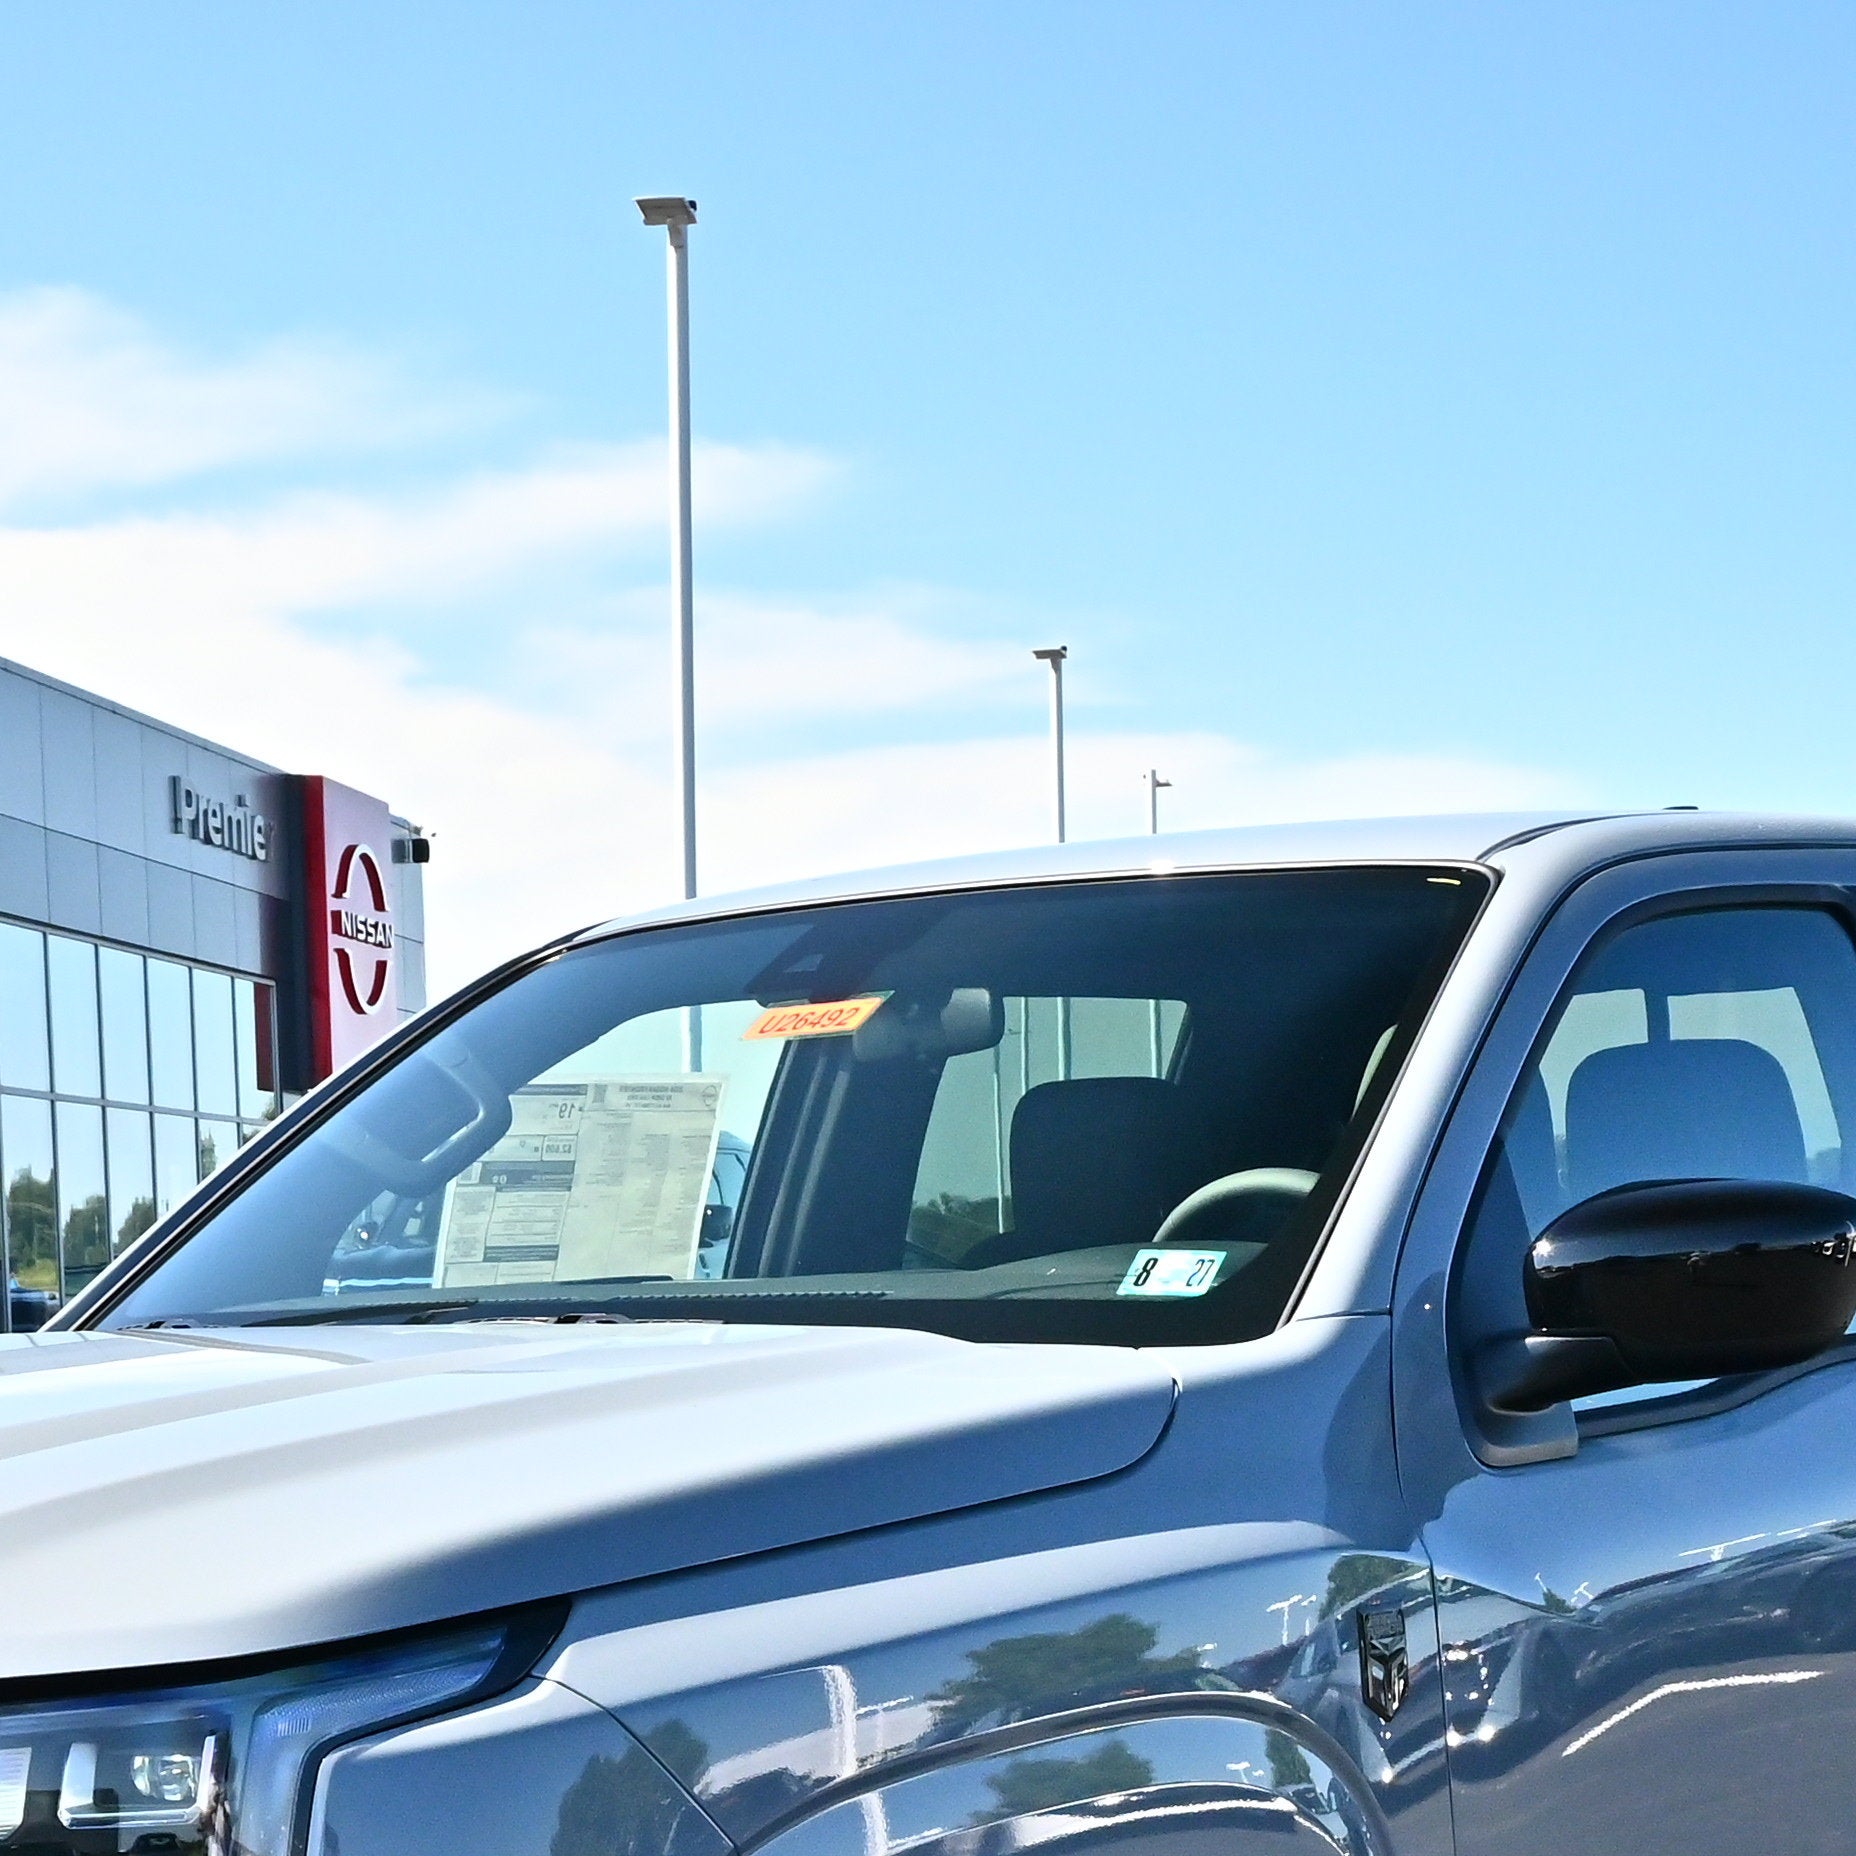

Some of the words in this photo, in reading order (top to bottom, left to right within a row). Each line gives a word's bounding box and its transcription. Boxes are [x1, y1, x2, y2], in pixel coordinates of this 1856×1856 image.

[341, 908, 393, 948] NISSAN
[759, 1007, 860, 1034] U26492
[1133, 1257, 1159, 1287] 8
[1186, 1258, 1216, 1287] 27
